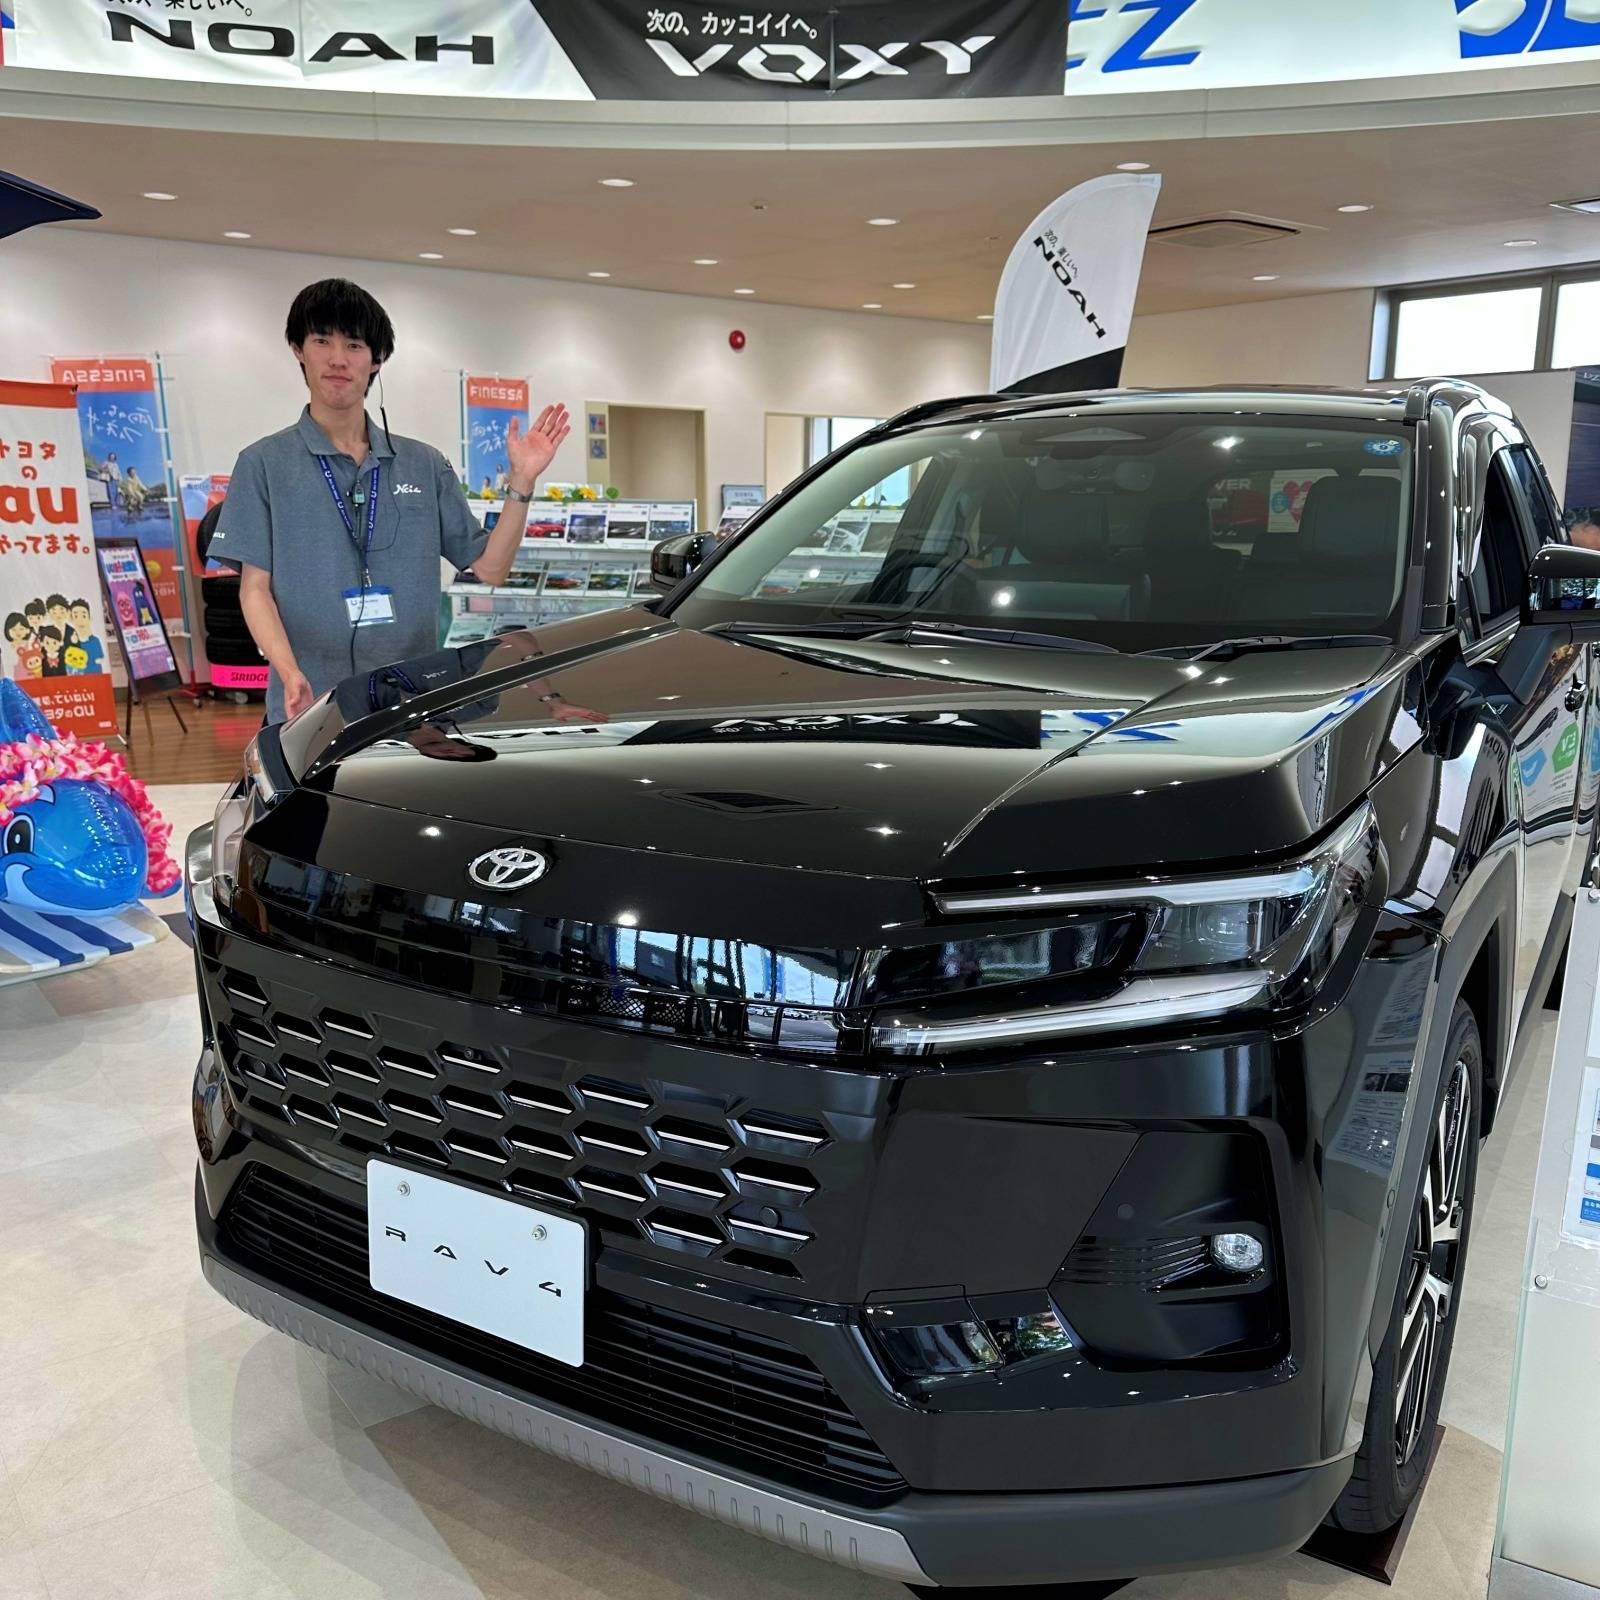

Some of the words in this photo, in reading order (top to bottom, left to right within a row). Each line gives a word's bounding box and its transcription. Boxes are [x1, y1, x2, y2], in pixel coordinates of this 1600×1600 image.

[106, 10, 495, 65] NOAH
[646, 8, 818, 40] 次の、カッコイイへ。
[644, 35, 996, 83] VOXY
[1033, 235, 1106, 339] NOAH
[469, 384, 524, 401] FINESSA
[21, 465, 38, 481] の
[0, 485, 79, 526] au
[385, 1225, 563, 1299] RAV4
